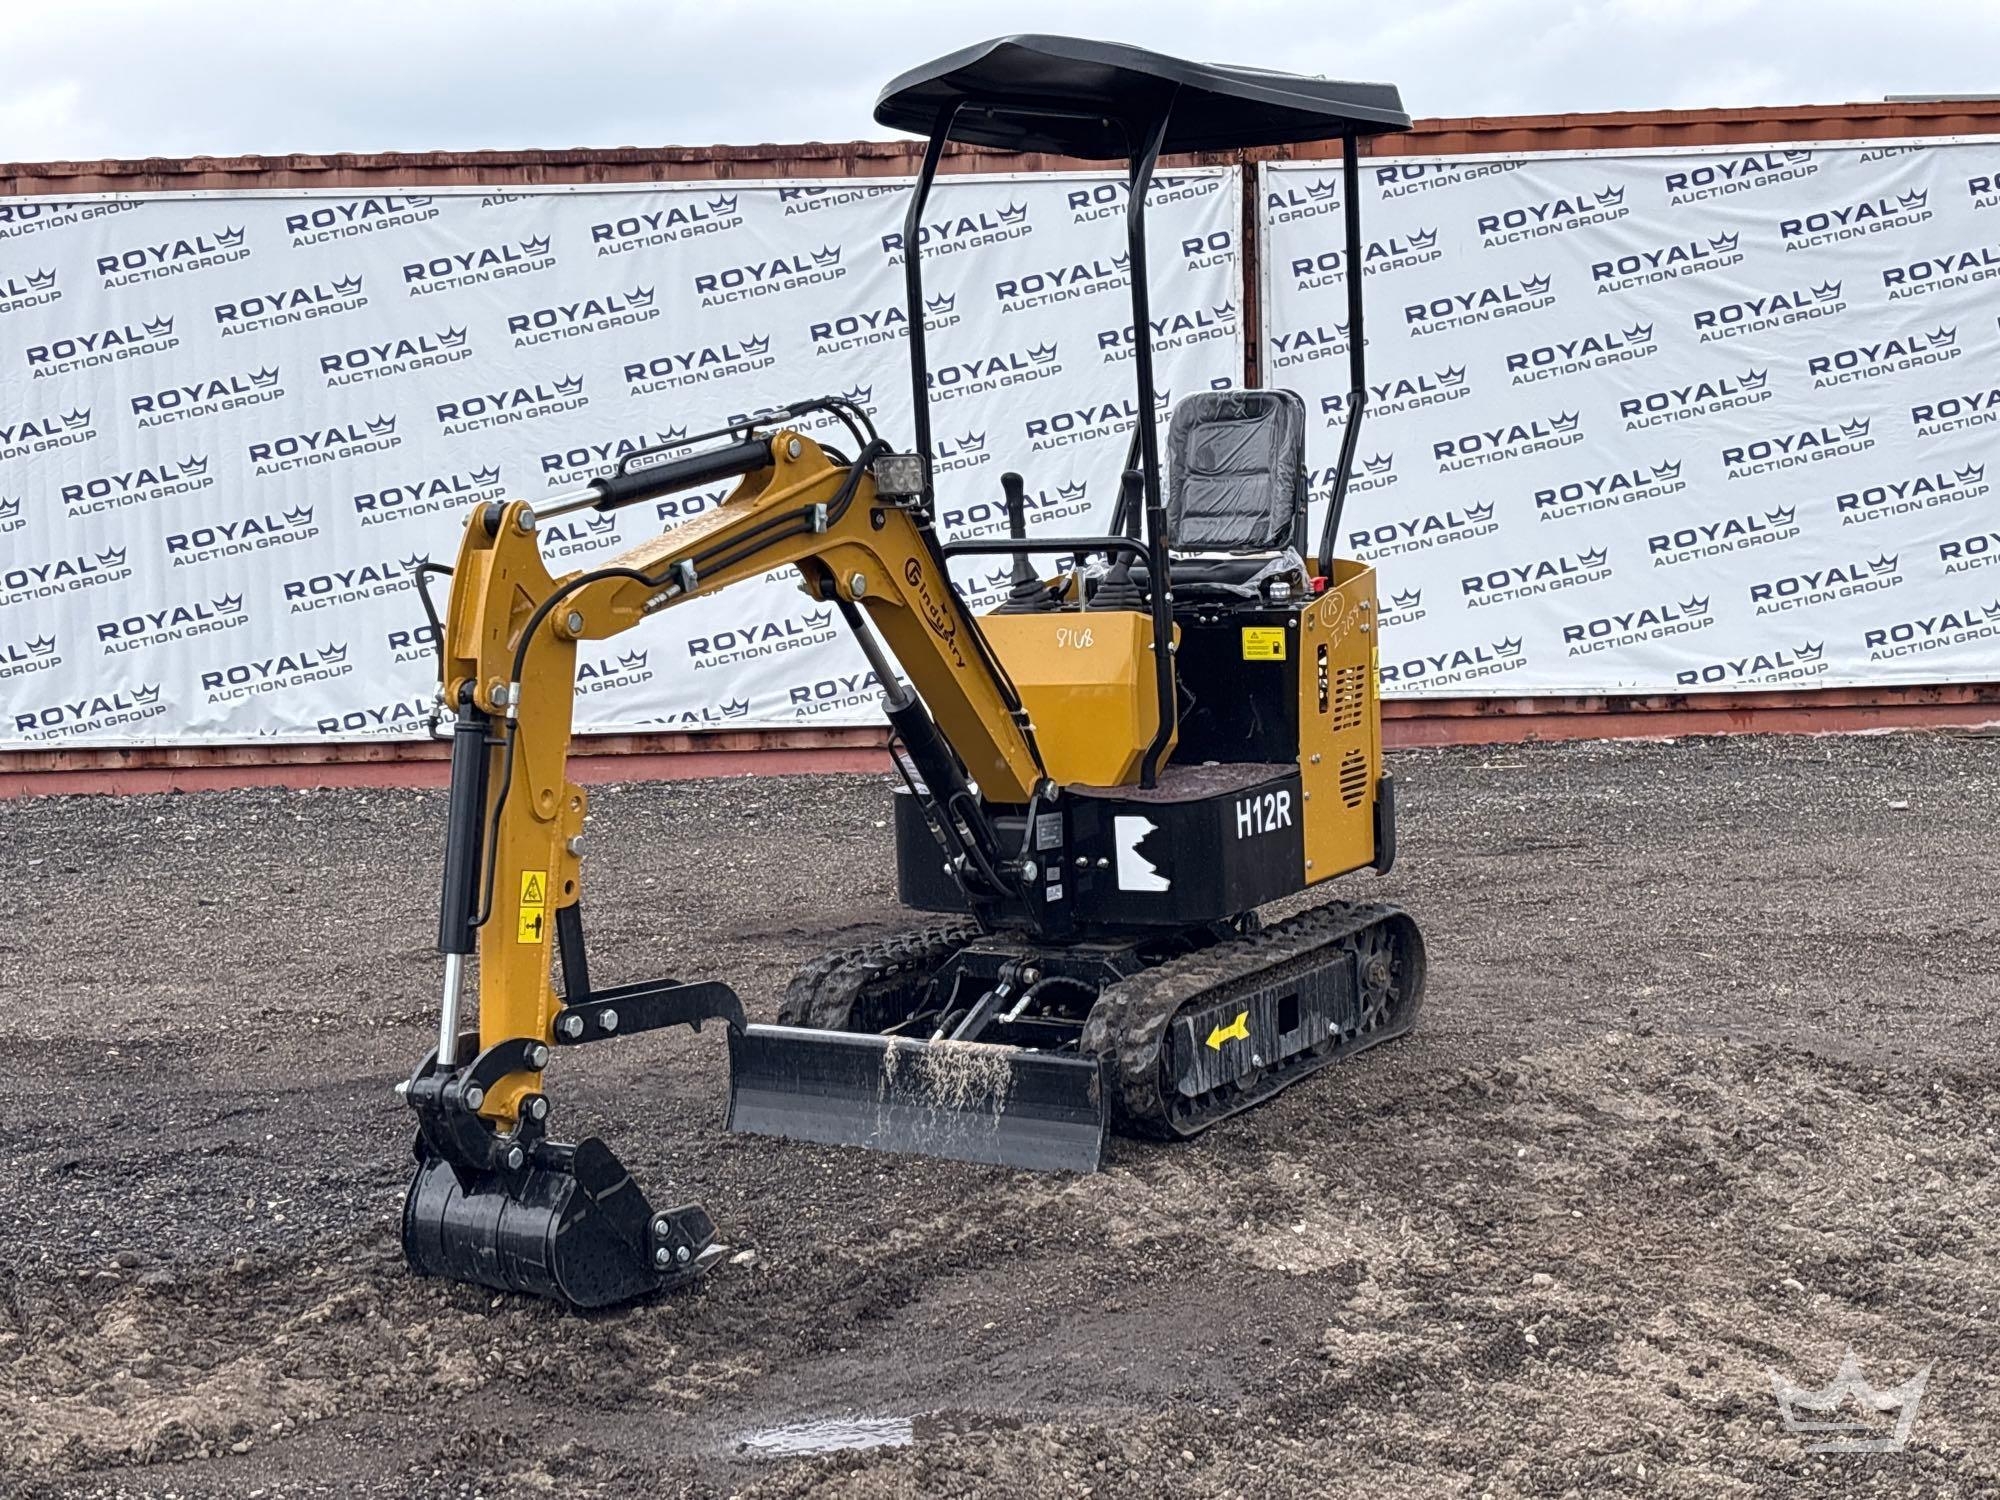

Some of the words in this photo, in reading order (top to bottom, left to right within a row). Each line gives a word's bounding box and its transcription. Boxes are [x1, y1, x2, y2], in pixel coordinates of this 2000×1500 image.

[1381, 173, 1461, 201] AUCTION
[1665, 152, 1783, 193] ROYAL
[1671, 179, 1752, 207] AUCTION
[1754, 164, 1819, 187] GROUP
[784, 189, 865, 217] AUCTION
[1156, 182, 1219, 205] GROUP
[1278, 201, 1341, 223] GROUP
[0, 212, 79, 240] AUCTION
[285, 195, 405, 235] ROYAL
[292, 222, 373, 249] AUCTION
[375, 208, 440, 230] GROUP
[590, 204, 710, 244] ROYAL
[1477, 195, 1596, 236] ROYAL
[1483, 222, 1563, 249] AUCTION
[1566, 207, 1630, 230] GROUP
[1779, 198, 1899, 239] ROYAL
[1785, 225, 1866, 253] AUCTION
[1869, 210, 1933, 233] GROUP
[96, 236, 216, 276] ROYAL
[597, 231, 677, 257] AUCTION
[680, 216, 743, 239] GROUP
[969, 225, 1033, 248] GROUP
[103, 262, 185, 290] AUCTION
[186, 248, 251, 271] GROUP
[402, 244, 522, 283] ROYAL
[409, 271, 490, 297] AUCTION
[492, 257, 556, 279] GROUP
[694, 255, 813, 295] ROYAL
[995, 260, 1113, 301] ROYAL
[1379, 250, 1442, 273] GROUP
[1591, 241, 1710, 282] ROYAL
[1597, 268, 1678, 295] AUCTION
[1680, 253, 1744, 276] GROUP
[1882, 247, 2000, 288] ROYAL
[0, 290, 62, 314] GROUP
[214, 284, 334, 324] ROYAL
[701, 282, 781, 308] AUCTION
[783, 267, 847, 290] GROUP
[1001, 287, 1081, 314] AUCTION
[1404, 284, 1522, 324] ROYAL
[1888, 274, 1969, 301] AUCTION
[221, 311, 302, 338] AUCTION
[304, 297, 369, 319] GROUP
[507, 295, 626, 335] ROYAL
[514, 322, 594, 349] AUCTION
[597, 308, 660, 331] GROUP
[1410, 310, 1490, 338] AUCTION
[1492, 296, 1556, 319] GROUP
[1693, 290, 1813, 331] ROYAL
[1699, 317, 1780, 344] AUCTION
[1782, 302, 1847, 325] GROUP
[26, 325, 145, 366] ROYAL
[33, 352, 114, 380] AUCTION
[116, 338, 180, 360] GROUP
[319, 335, 439, 375] ROYAL
[816, 329, 895, 356] AUCTION
[1505, 333, 1624, 373] ROYAL
[1808, 336, 1928, 377] ROYAL
[326, 362, 407, 388] AUCTION
[409, 348, 473, 370] GROUP
[623, 344, 742, 383] ROYAL
[630, 370, 710, 397] AUCTION
[712, 356, 776, 379] GROUP
[1000, 364, 1063, 387] GROUP
[1511, 359, 1592, 386] AUCTION
[1594, 344, 1658, 367] GROUP
[1814, 362, 1895, 390] AUCTION
[1897, 348, 1962, 370] GROUP
[130, 376, 251, 416] ROYAL
[137, 402, 219, 429] AUCTION
[221, 388, 285, 411] GROUP
[436, 384, 555, 423] ROYAL
[1408, 387, 1471, 409] GROUP
[1619, 378, 1739, 419] ROYAL
[1625, 405, 1706, 432] AUCTION
[1708, 390, 1773, 413] GROUP
[443, 410, 523, 437] AUCTION
[525, 397, 589, 419] GROUP
[1917, 411, 1997, 438] AUCTION
[33, 429, 97, 452] GROUP
[248, 424, 368, 463] ROYAL
[255, 450, 336, 477] AUCTION
[338, 436, 402, 458] GROUP
[1031, 426, 1110, 453] AUCTION
[1433, 421, 1551, 461] ROYAL
[1439, 447, 1518, 474] AUCTION
[1521, 432, 1584, 455] GROUP
[1721, 427, 1841, 467] ROYAL
[1727, 454, 1808, 481] AUCTION
[1811, 439, 1875, 461] GROUP
[60, 465, 180, 505] ROYAL
[68, 491, 147, 518] AUCTION
[150, 477, 214, 499] GROUP
[353, 474, 472, 514] ROYAL
[1534, 469, 1653, 509] ROYAL
[1540, 495, 1620, 522] AUCTION
[1622, 481, 1686, 503] GROUP
[1836, 473, 1956, 513] ROYAL
[360, 501, 440, 527] AUCTION
[442, 487, 506, 509] GROUP
[1029, 502, 1092, 524] GROUP
[1842, 499, 1923, 526] AUCTION
[1926, 485, 1990, 507] GROUP
[165, 515, 285, 554] ROYAL
[173, 541, 253, 568] AUCTION
[255, 527, 319, 549] GROUP
[558, 535, 622, 557] GROUP
[1348, 511, 1466, 550] ROYAL
[1355, 537, 1433, 562] AUCTION
[1436, 523, 1499, 545] GROUP
[1647, 515, 1767, 555] ROYAL
[1654, 541, 1734, 568] AUCTION
[1737, 527, 1800, 549] GROUP
[68, 568, 132, 591] GROUP
[283, 562, 402, 601] ROYAL
[1461, 557, 1579, 596] ROYAL
[1467, 583, 1546, 609] AUCTION
[1549, 568, 1612, 591] GROUP
[1749, 564, 1869, 603] ROYAL
[1755, 590, 1836, 616] AUCTION
[1839, 575, 1903, 598] GROUP
[290, 588, 370, 615] AUCTION
[96, 603, 215, 642] ROYAL
[104, 629, 183, 656] AUCTION
[185, 614, 249, 637] GROUP
[687, 618, 804, 657] ROYAL
[1562, 605, 1681, 644] ROYAL
[1568, 631, 1648, 657] AUCTION
[1651, 617, 1714, 639] GROUP
[1864, 609, 1984, 649] ROYAL
[0, 656, 62, 679] GROUP
[694, 645, 772, 671] AUCTION
[775, 630, 837, 652] GROUP
[1378, 646, 1494, 684] ROYAL
[1464, 658, 1527, 680] GROUP
[1676, 651, 1794, 685] ROYAL
[1870, 636, 1951, 662] AUCTION
[201, 652, 320, 691] ROYAL
[207, 678, 288, 705] AUCTION
[290, 664, 353, 686] GROUP
[590, 671, 653, 692] GROUP
[14, 693, 133, 733] ROYAL
[104, 705, 167, 727] GROUP
[795, 692, 873, 717] AUCTION
[1235, 789, 1293, 840] H12R
